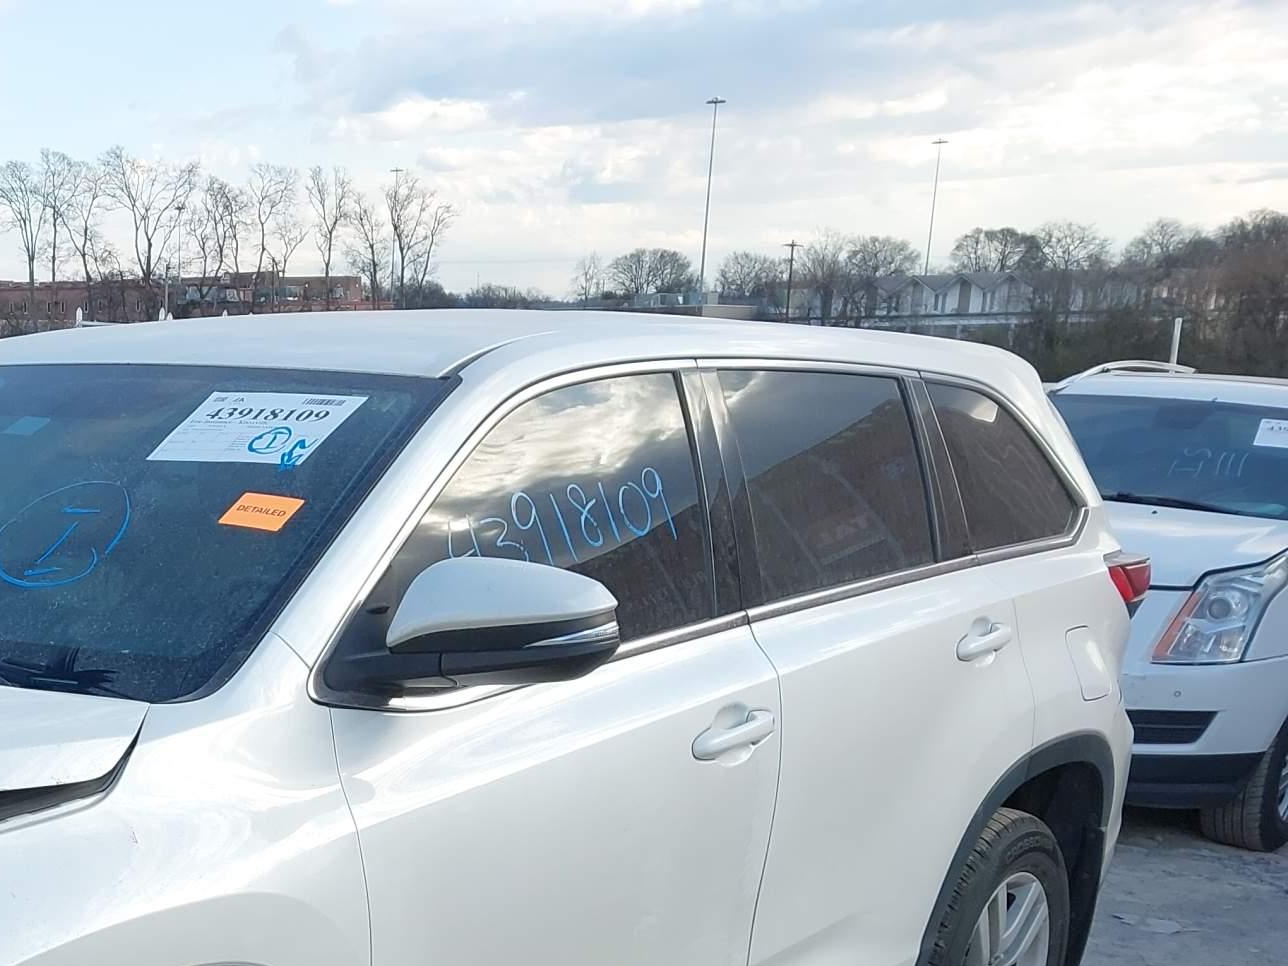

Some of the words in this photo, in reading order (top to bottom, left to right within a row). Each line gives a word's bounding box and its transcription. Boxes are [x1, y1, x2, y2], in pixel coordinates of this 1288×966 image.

[206, 407, 330, 422] 43918109
[236, 504, 287, 517] DETAILED
[448, 467, 677, 566] 43918109
